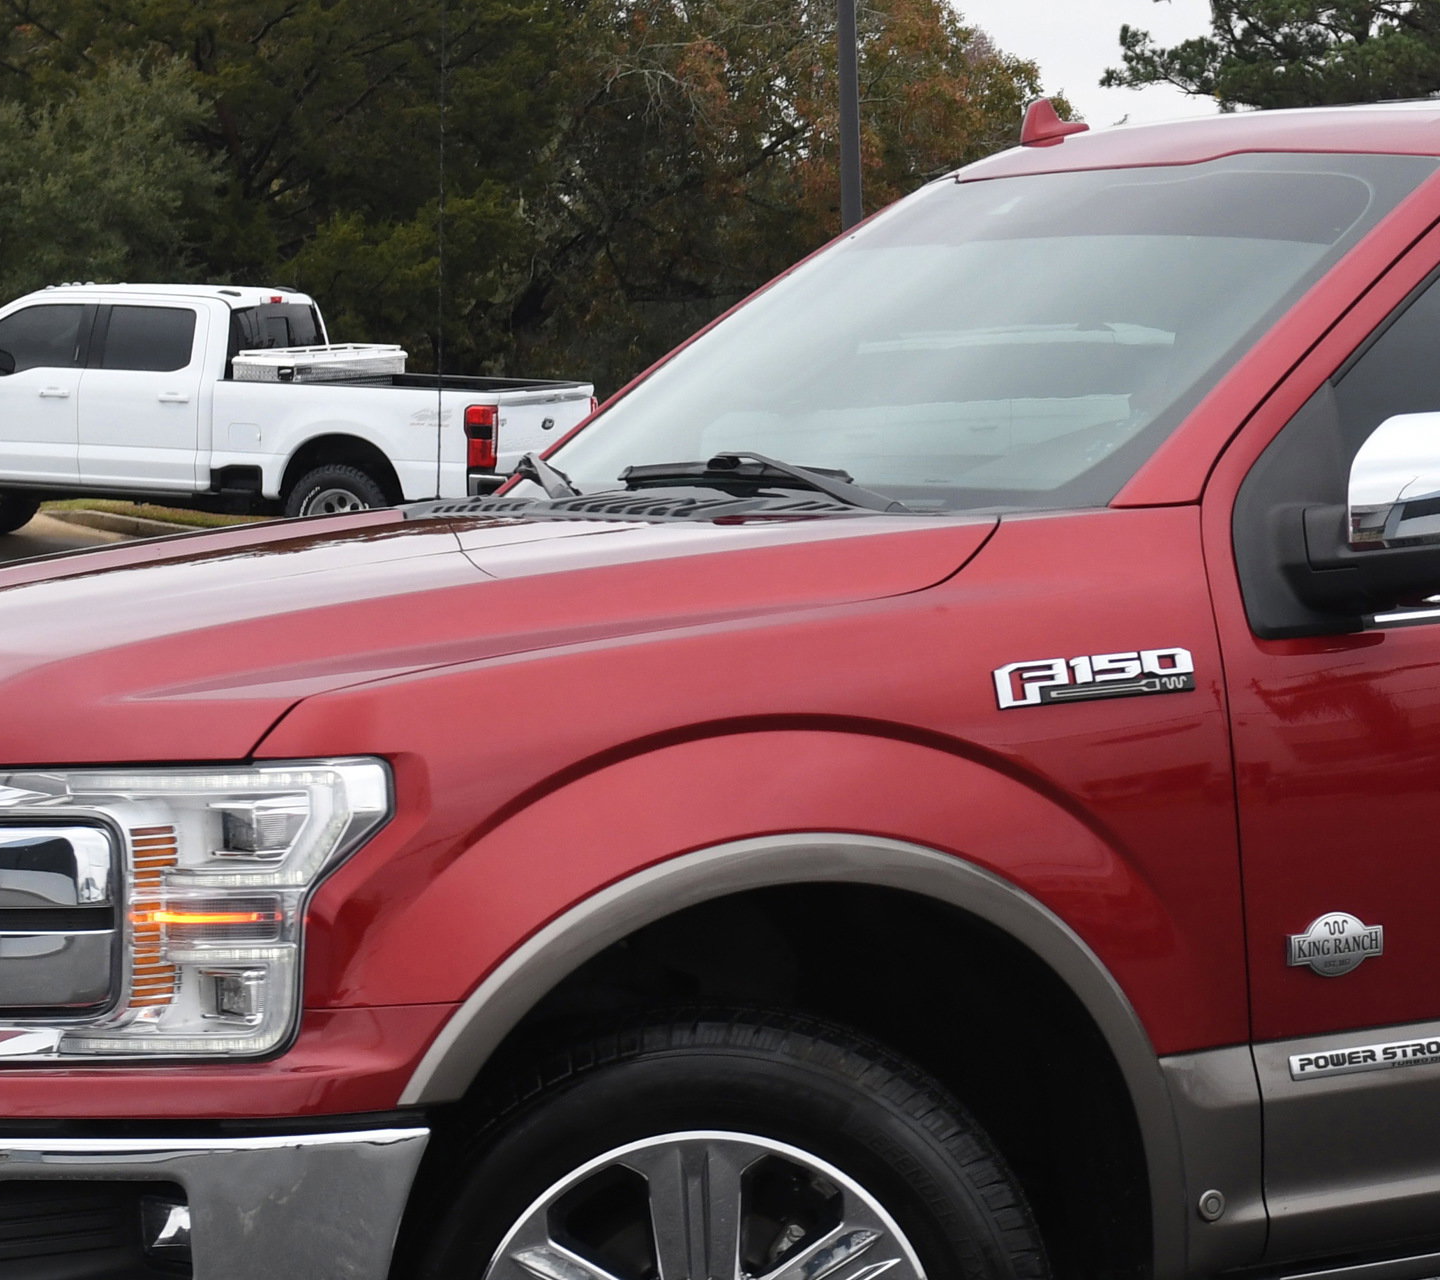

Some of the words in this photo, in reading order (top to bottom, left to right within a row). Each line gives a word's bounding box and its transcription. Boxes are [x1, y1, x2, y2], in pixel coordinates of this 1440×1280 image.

[1296, 939, 1330, 959] KING
[1334, 931, 1379, 954] RANCH
[1298, 1049, 1377, 1072] POWER
[1391, 1057, 1428, 1067] TURBO
